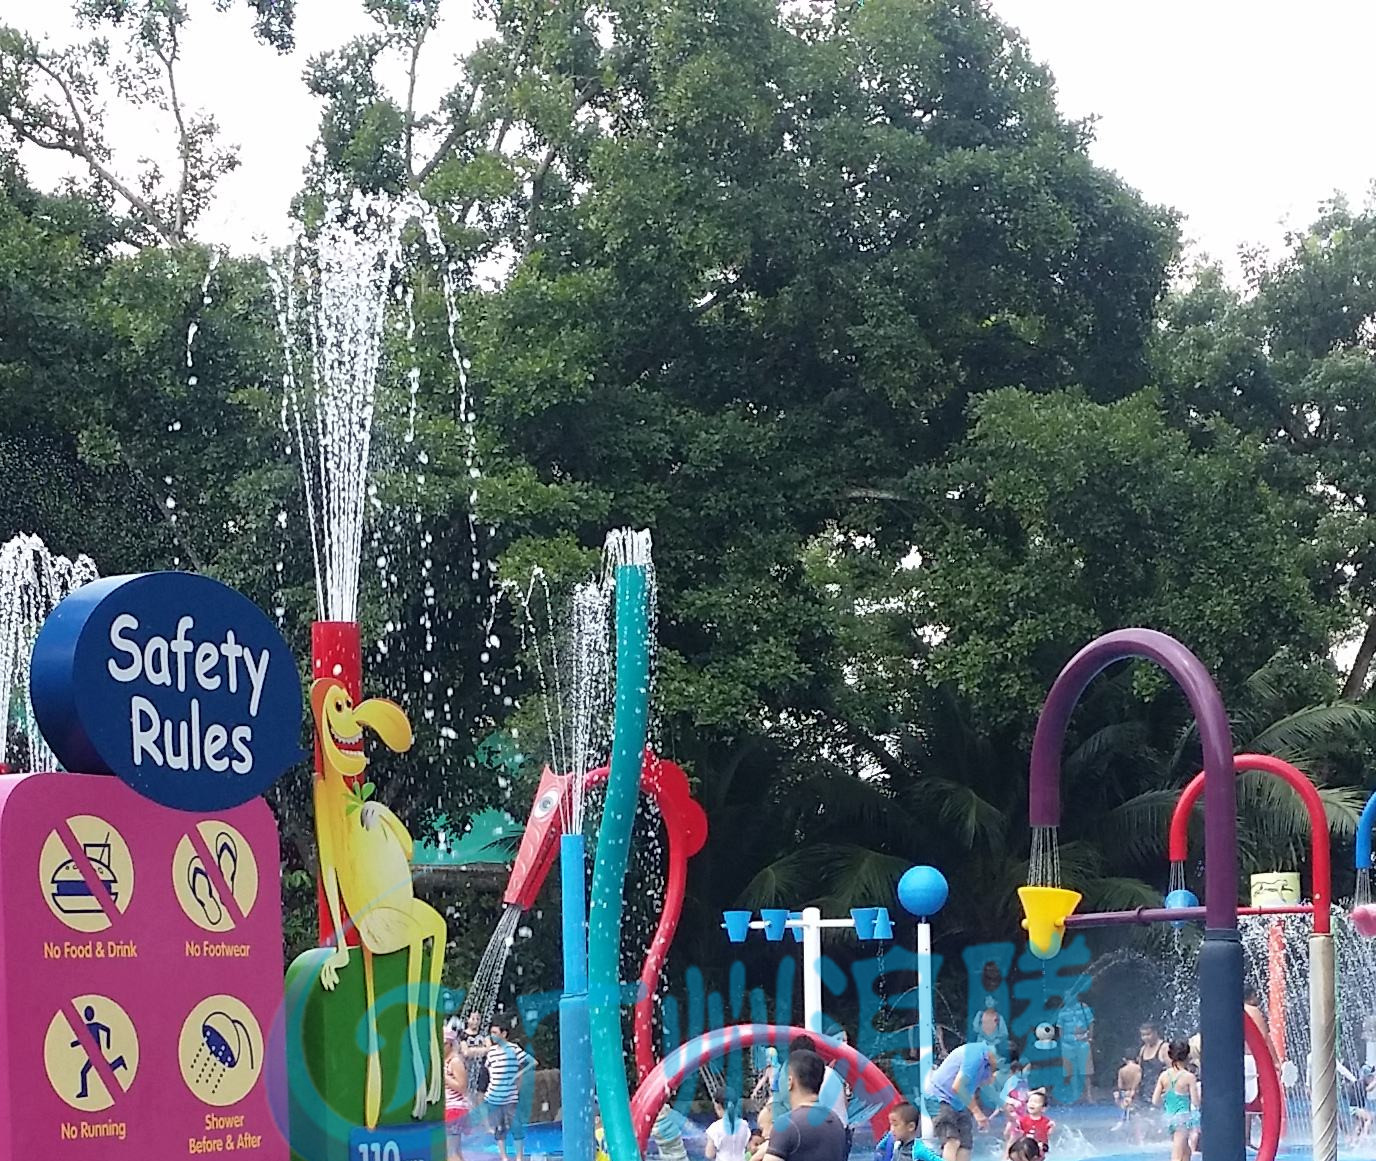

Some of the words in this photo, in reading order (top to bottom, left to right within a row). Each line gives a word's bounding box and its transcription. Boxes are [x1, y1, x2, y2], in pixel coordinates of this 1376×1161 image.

[107, 613, 270, 716] Safety
[131, 695, 254, 775] Rules
[44, 942, 61, 959] No
[64, 941, 93, 958] Food
[96, 942, 105, 958] &
[107, 941, 137, 958] Drink
[186, 940, 201, 957] No
[203, 940, 250, 957] Footwear
[61, 1123, 78, 1140] No
[80, 1119, 126, 1140] Running
[205, 1113, 245, 1130] Shower
[189, 1135, 223, 1154] Before
[225, 1135, 235, 1151] &
[237, 1132, 262, 1150] After
